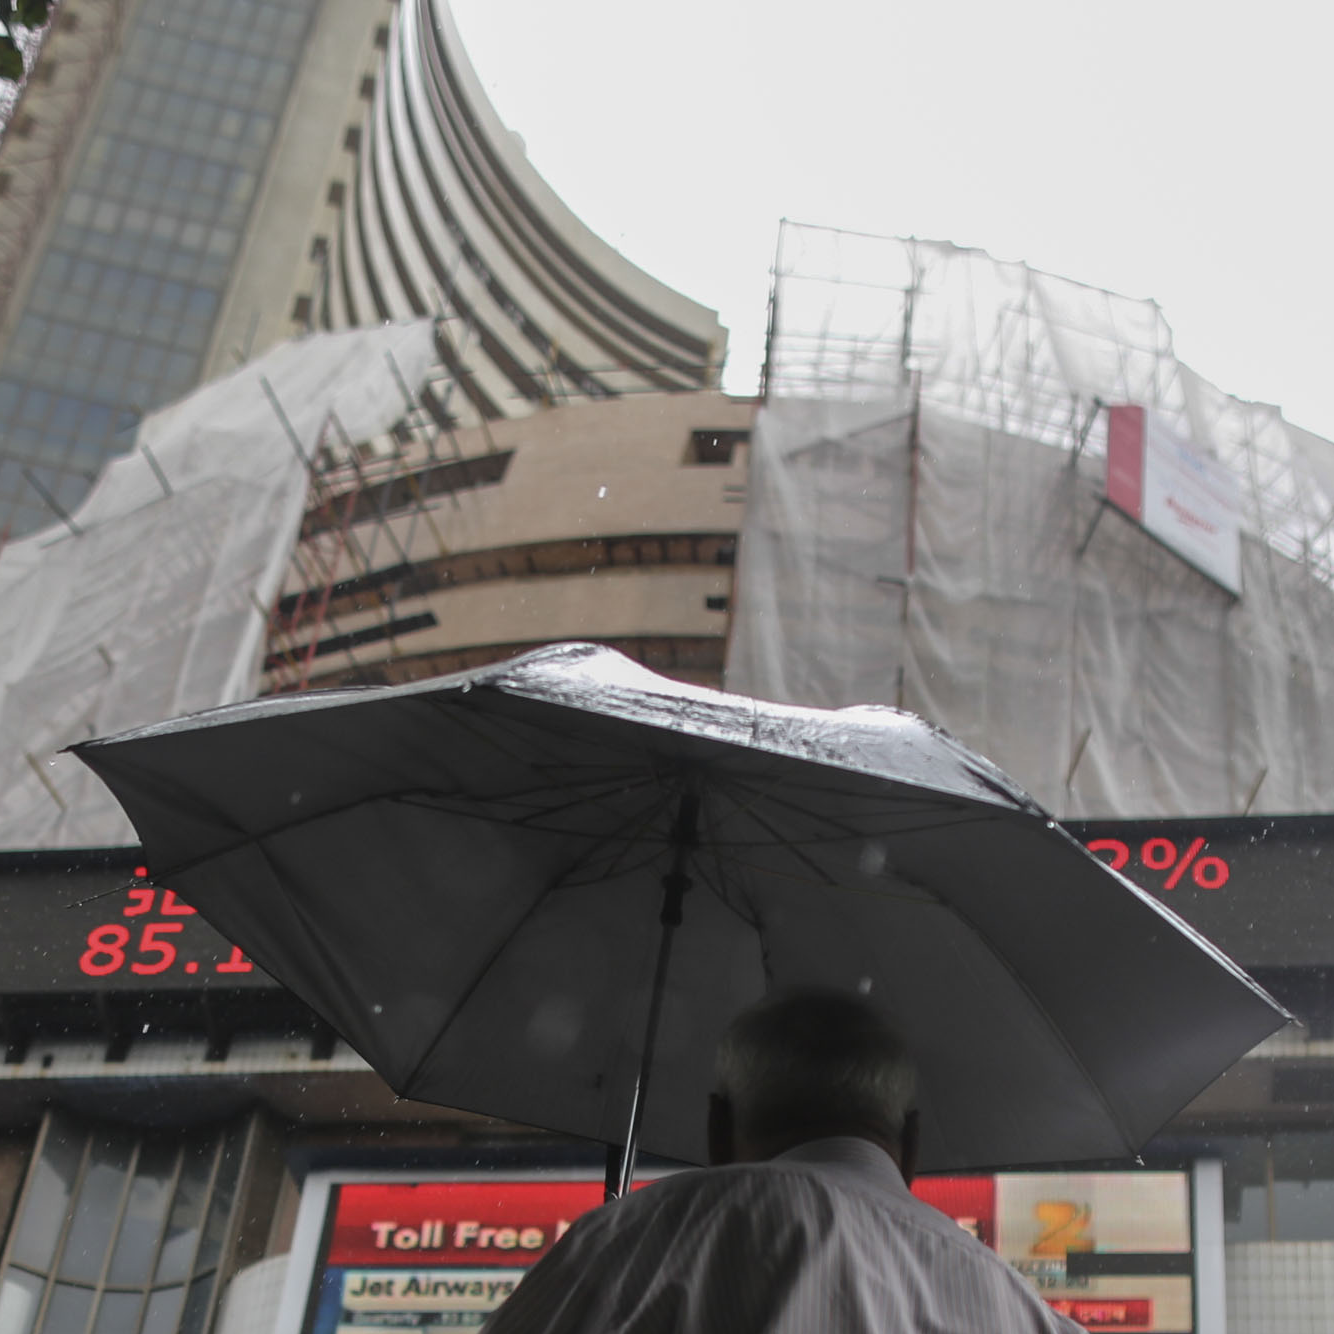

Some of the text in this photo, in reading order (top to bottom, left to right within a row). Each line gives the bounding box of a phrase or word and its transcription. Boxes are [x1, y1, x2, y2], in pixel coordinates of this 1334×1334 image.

[371, 1220, 443, 1249] Toll
[454, 1220, 544, 1249] Free
[351, 1275, 516, 1301] Jet Airways
